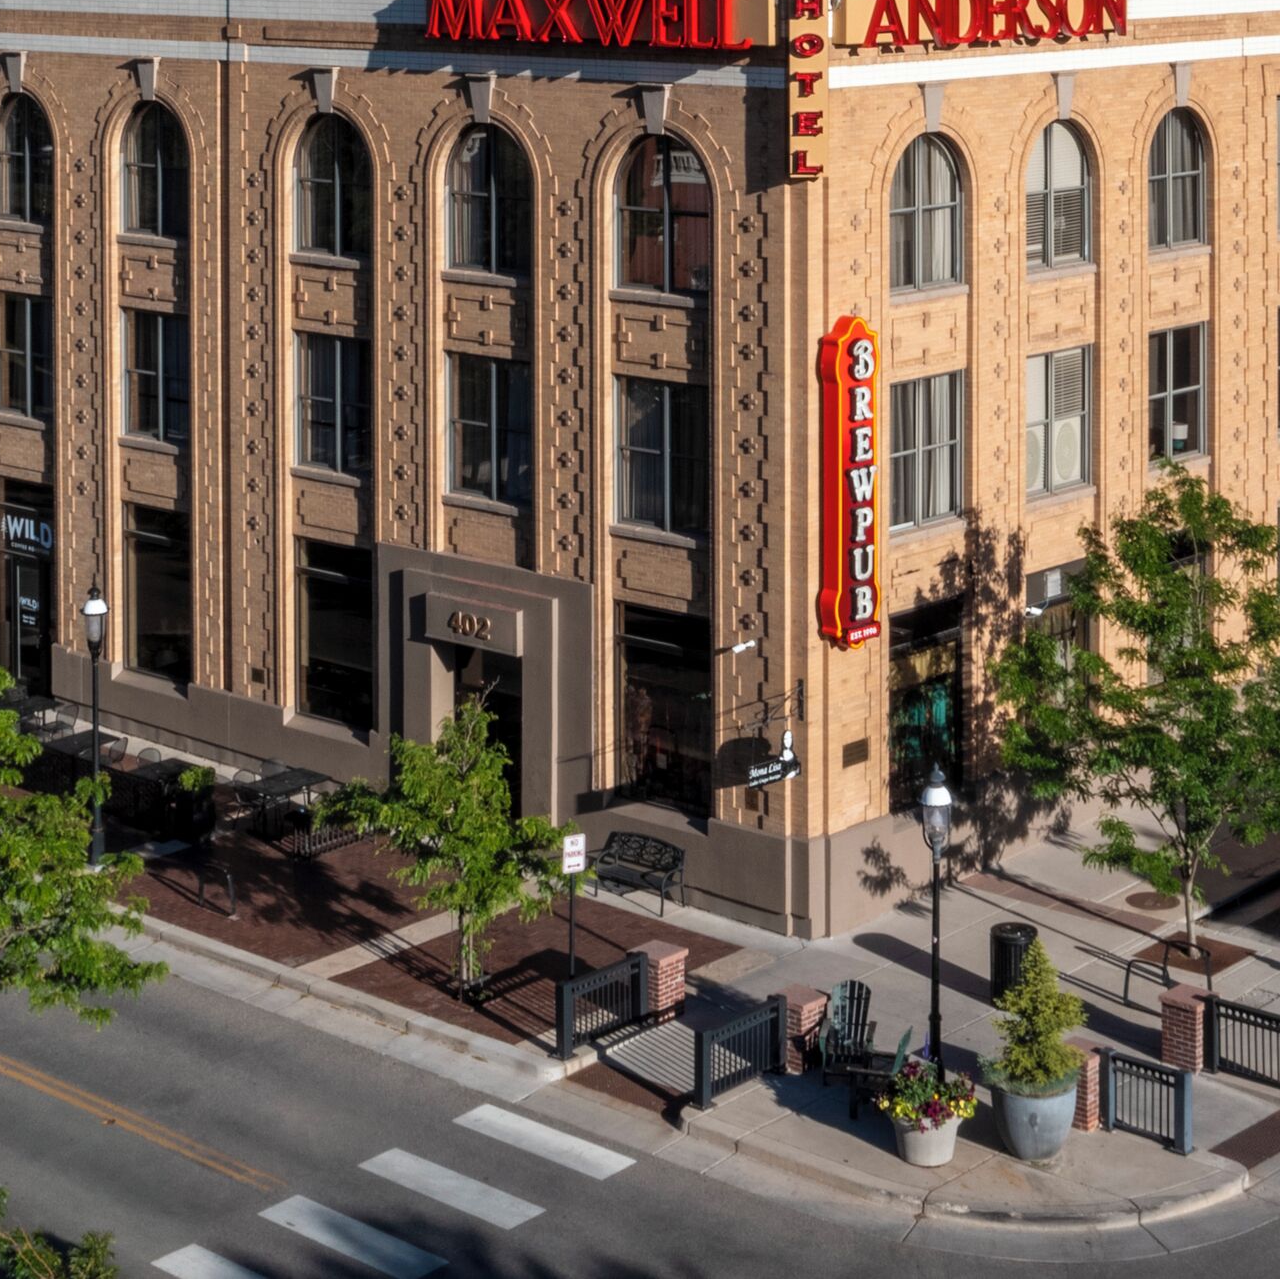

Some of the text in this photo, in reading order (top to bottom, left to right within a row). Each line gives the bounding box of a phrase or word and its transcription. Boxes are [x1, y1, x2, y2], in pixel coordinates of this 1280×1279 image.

[851, 339, 877, 620] BREWPUB
[7, 514, 53, 549] WILD
[448, 610, 491, 641] 402
[749, 762, 782, 779] Mona Lisa
